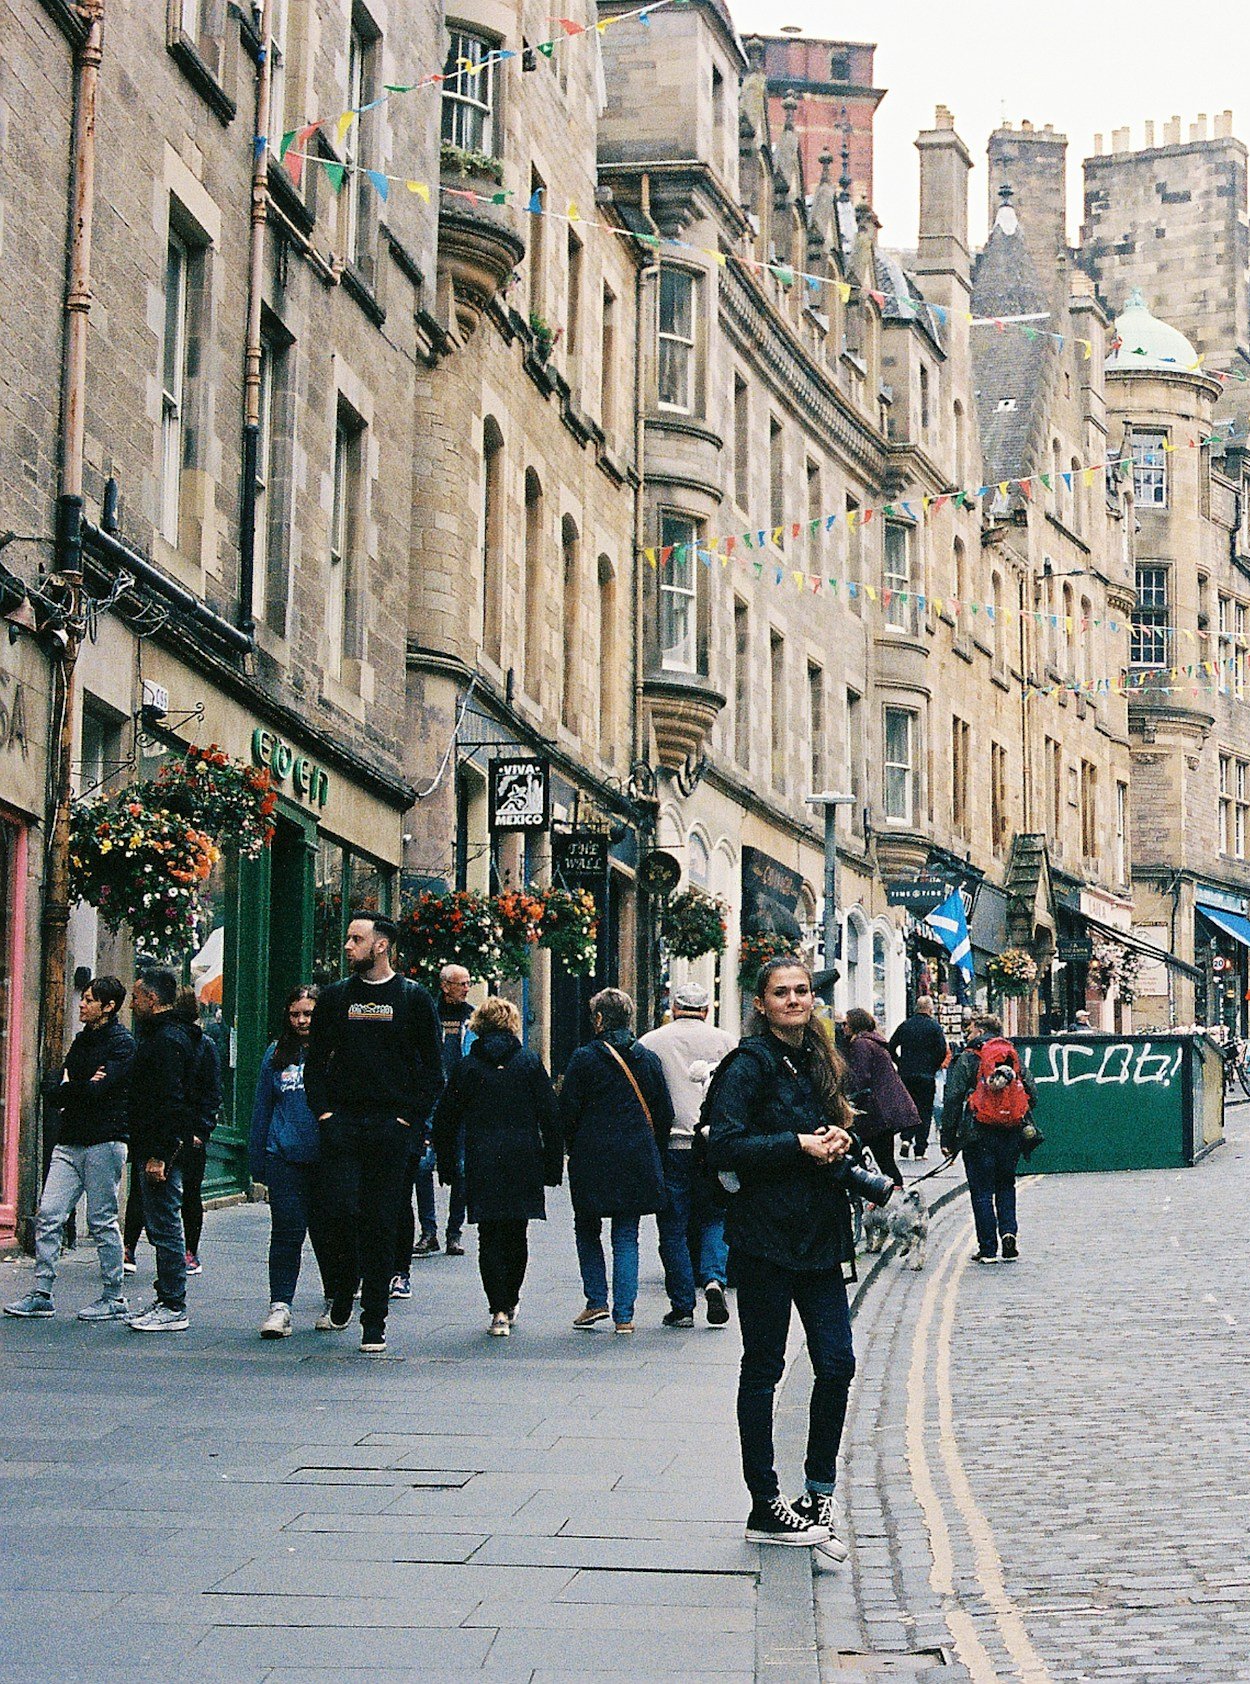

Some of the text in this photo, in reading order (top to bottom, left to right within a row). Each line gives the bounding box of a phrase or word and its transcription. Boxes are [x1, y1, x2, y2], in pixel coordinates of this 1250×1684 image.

[503, 764, 536, 775] VIVA
[495, 813, 543, 826] MEXICO
[568, 841, 600, 855] THE
[564, 857, 602, 870] WALL
[1213, 957, 1224, 968] 20
